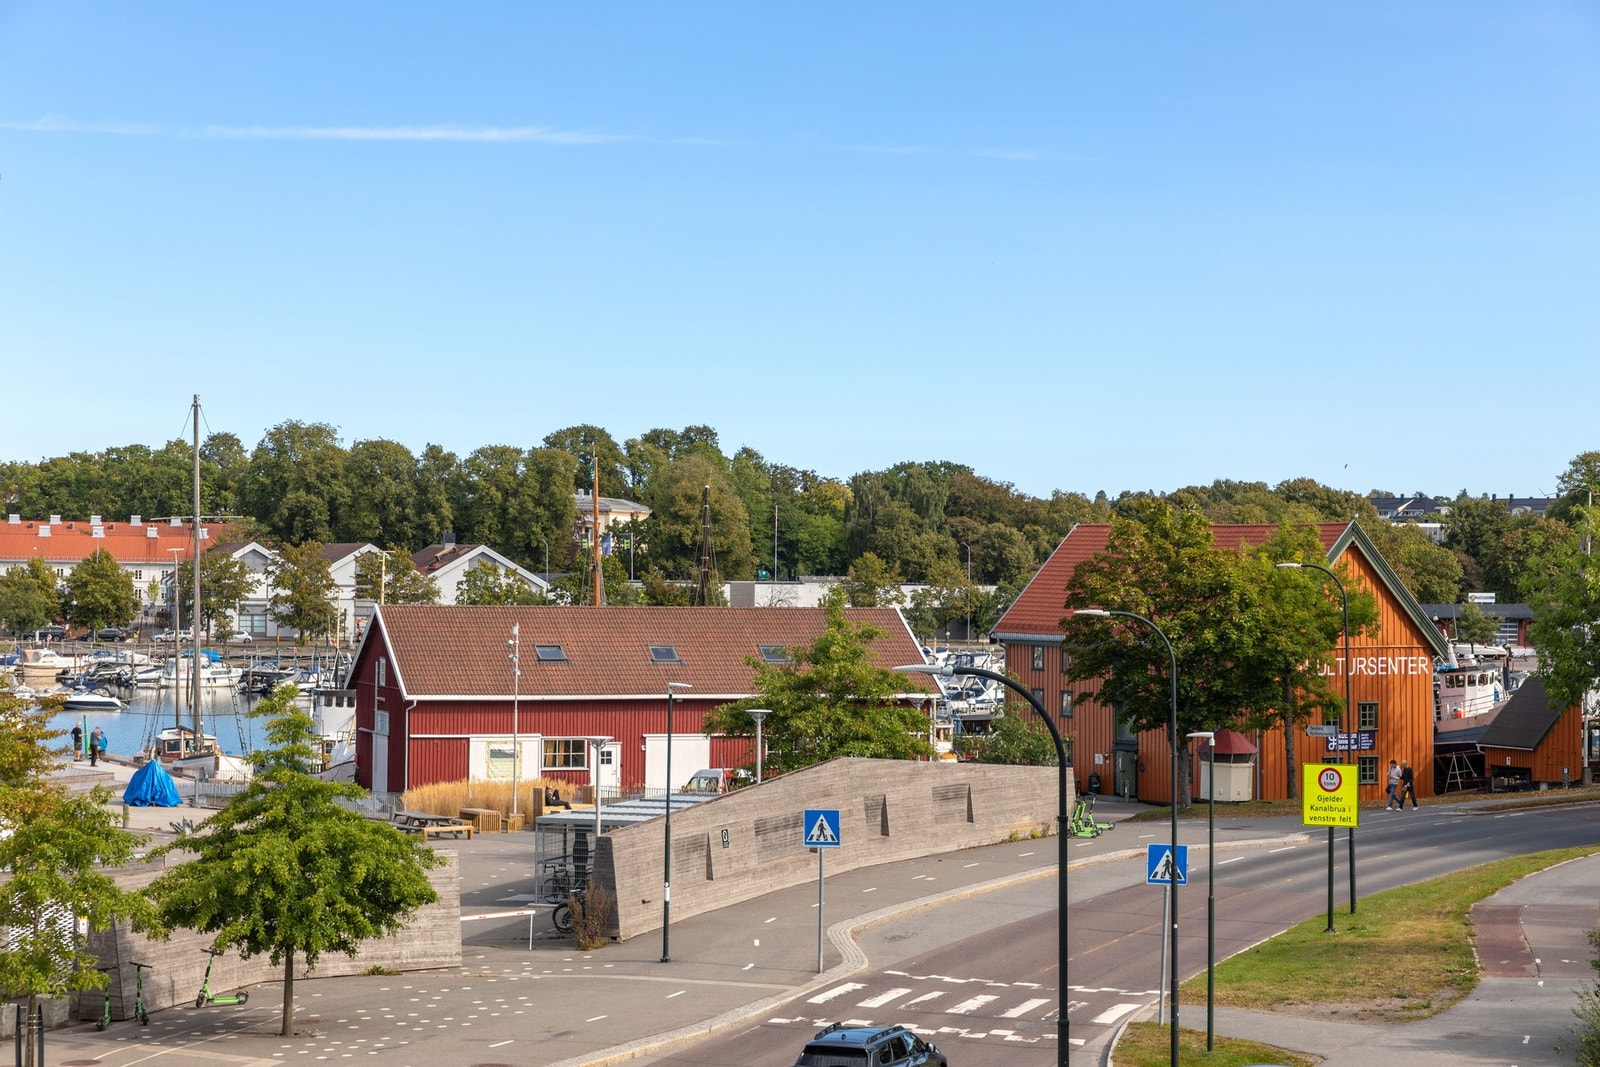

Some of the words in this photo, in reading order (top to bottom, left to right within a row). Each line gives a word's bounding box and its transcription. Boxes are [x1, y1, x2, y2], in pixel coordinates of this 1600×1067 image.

[1325, 773, 1335, 781] 10
[1317, 794, 1343, 803] Gjelder
[1310, 804, 1346, 812] Kanalbrua
[1339, 815, 1352, 823] felt
